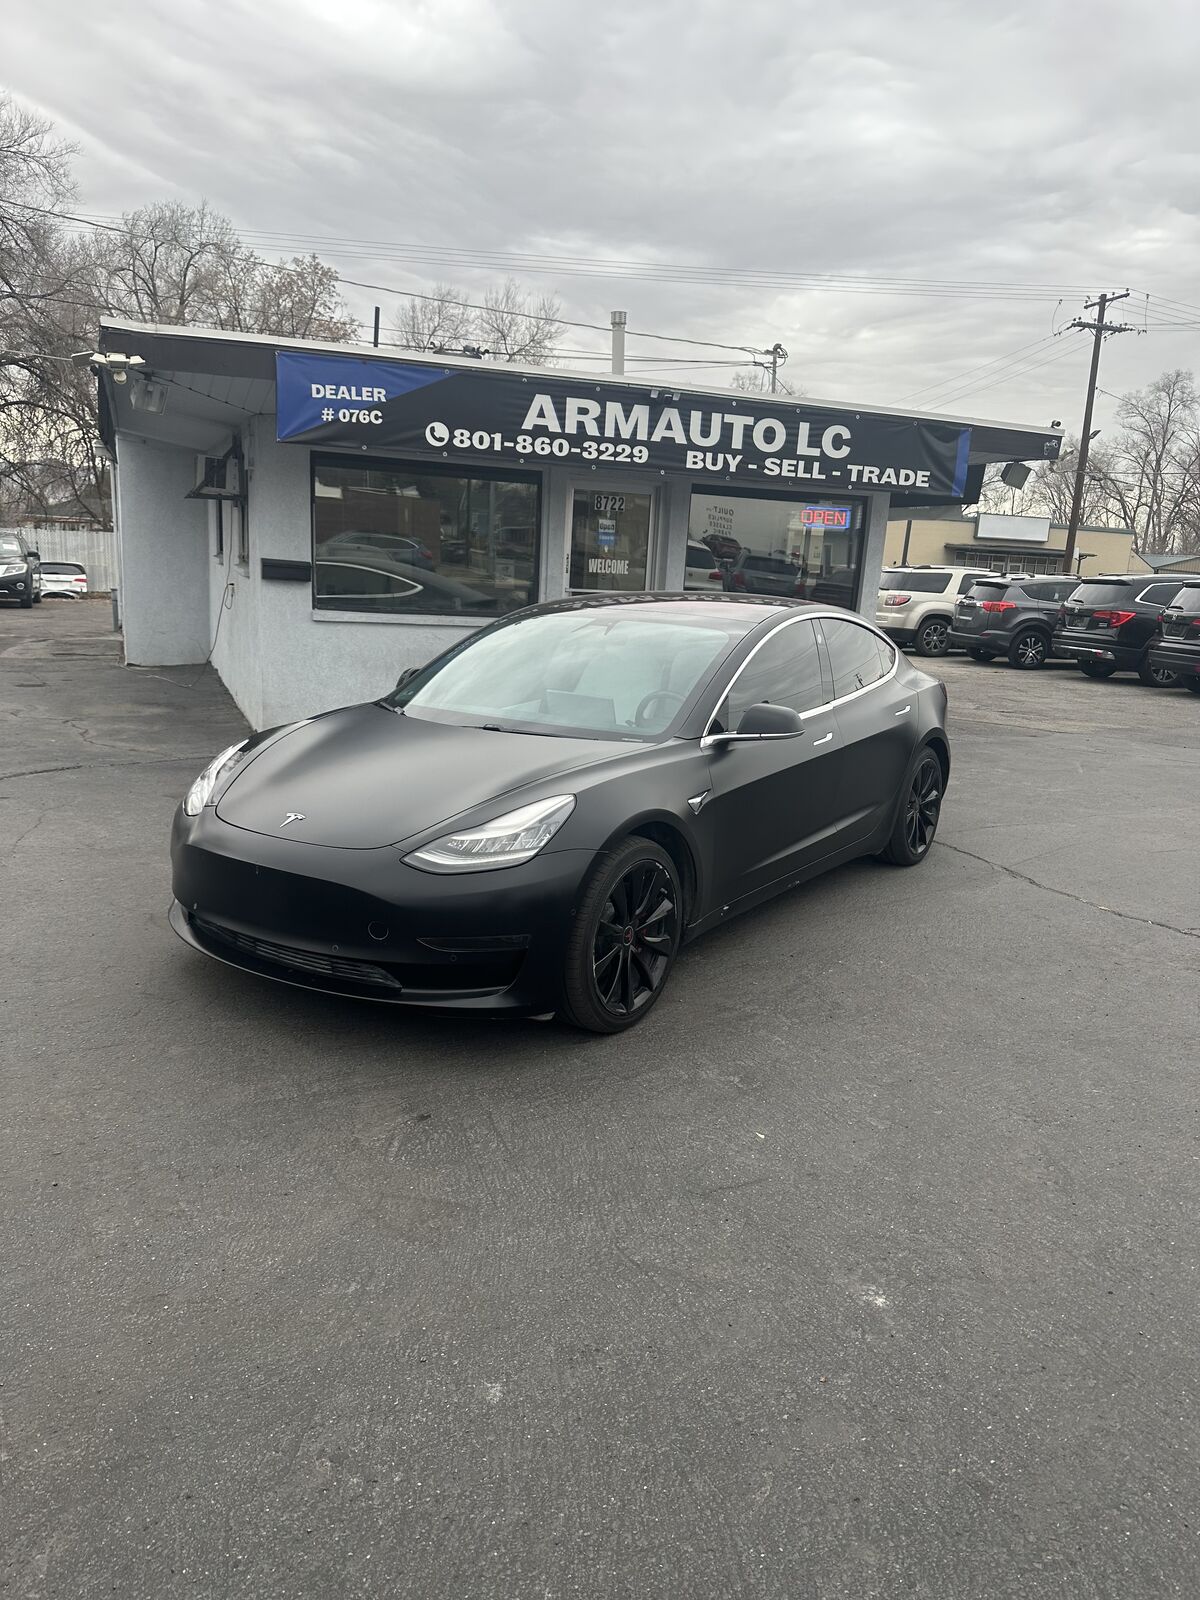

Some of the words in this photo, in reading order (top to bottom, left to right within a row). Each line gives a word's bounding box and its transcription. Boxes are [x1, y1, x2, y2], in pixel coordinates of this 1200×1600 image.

[311, 383, 387, 403] DEALER
[321, 407, 335, 422] #
[338, 408, 383, 425] 076C
[521, 393, 787, 453] ARMAUTO
[796, 421, 852, 459] LC
[452, 428, 649, 464] 801-860-3229
[685, 450, 744, 473] BUY
[763, 457, 826, 480] SELL
[846, 464, 931, 488] TRADE
[595, 495, 625, 511] 8722
[801, 509, 846, 526] OPEN
[588, 558, 629, 575] WELCOME
